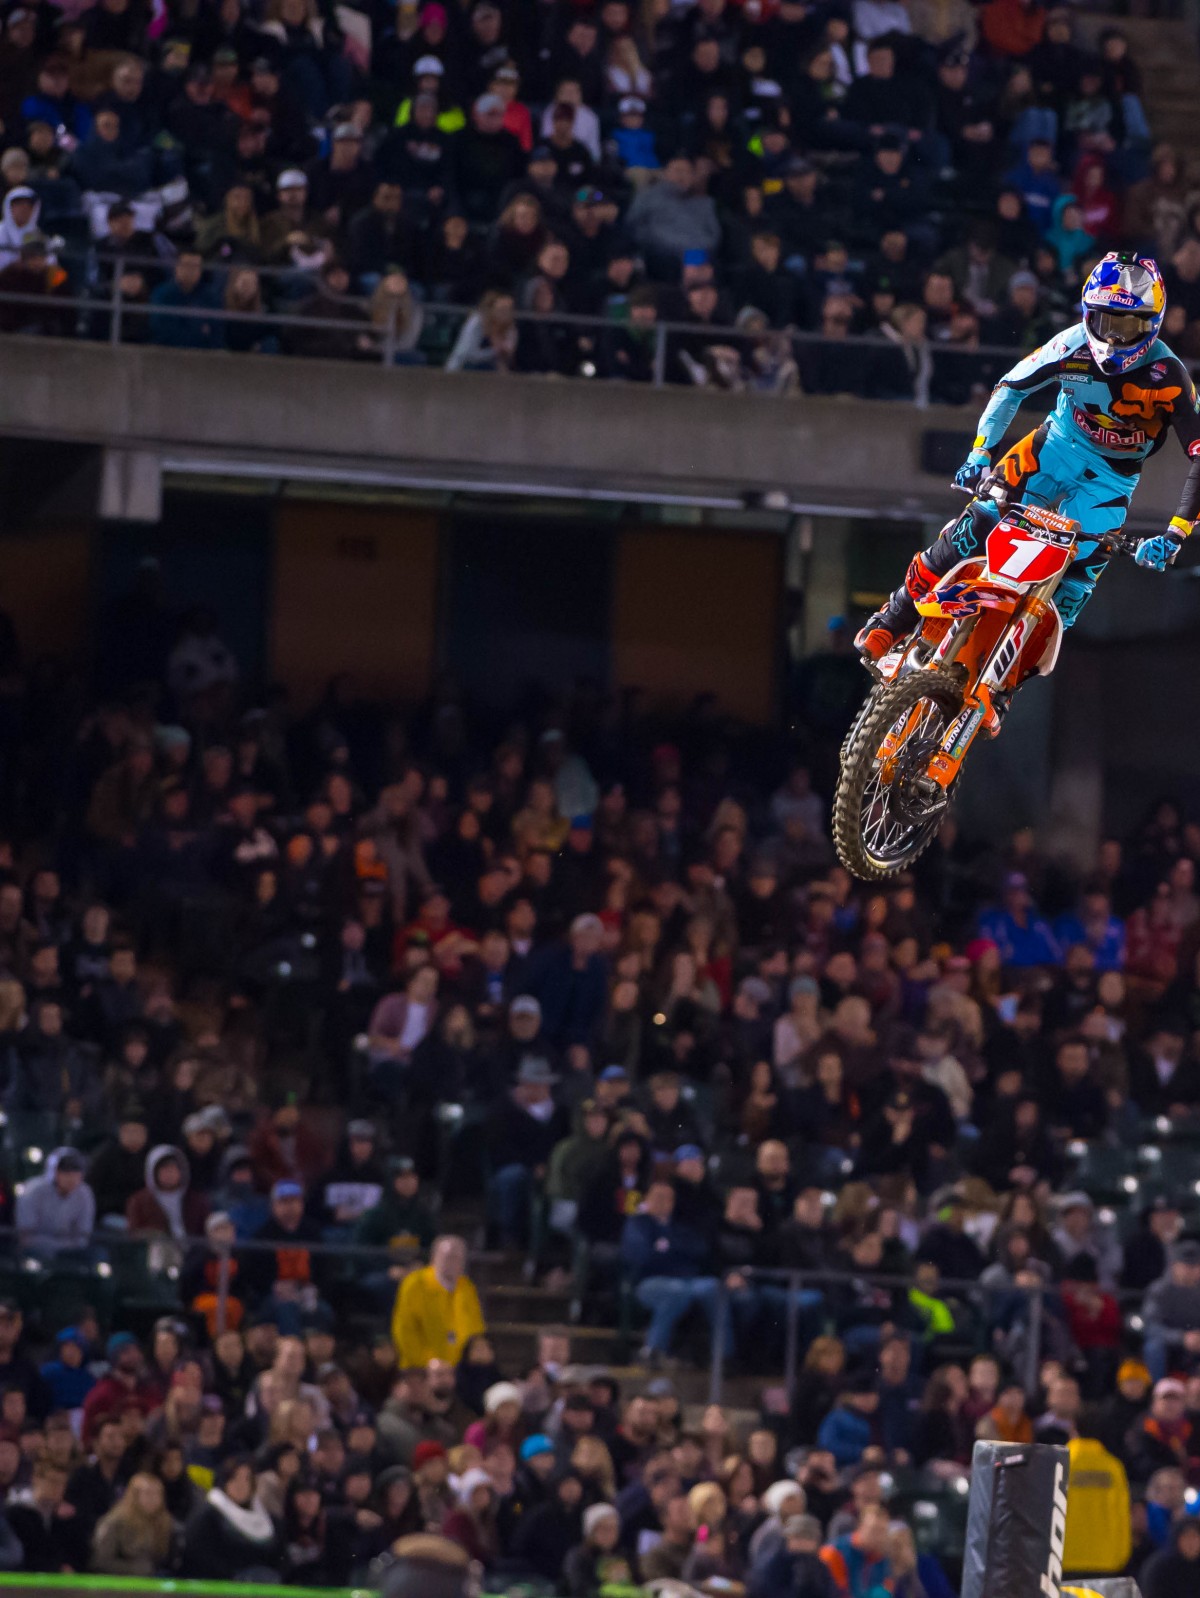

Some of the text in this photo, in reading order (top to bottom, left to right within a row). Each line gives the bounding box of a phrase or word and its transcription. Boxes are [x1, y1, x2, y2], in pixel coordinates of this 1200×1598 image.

[1090, 293, 1134, 306] Red Bull
[1074, 408, 1145, 444] Red Bull
[998, 538, 1049, 579] 1
[959, 710, 983, 748] MOTOREX
